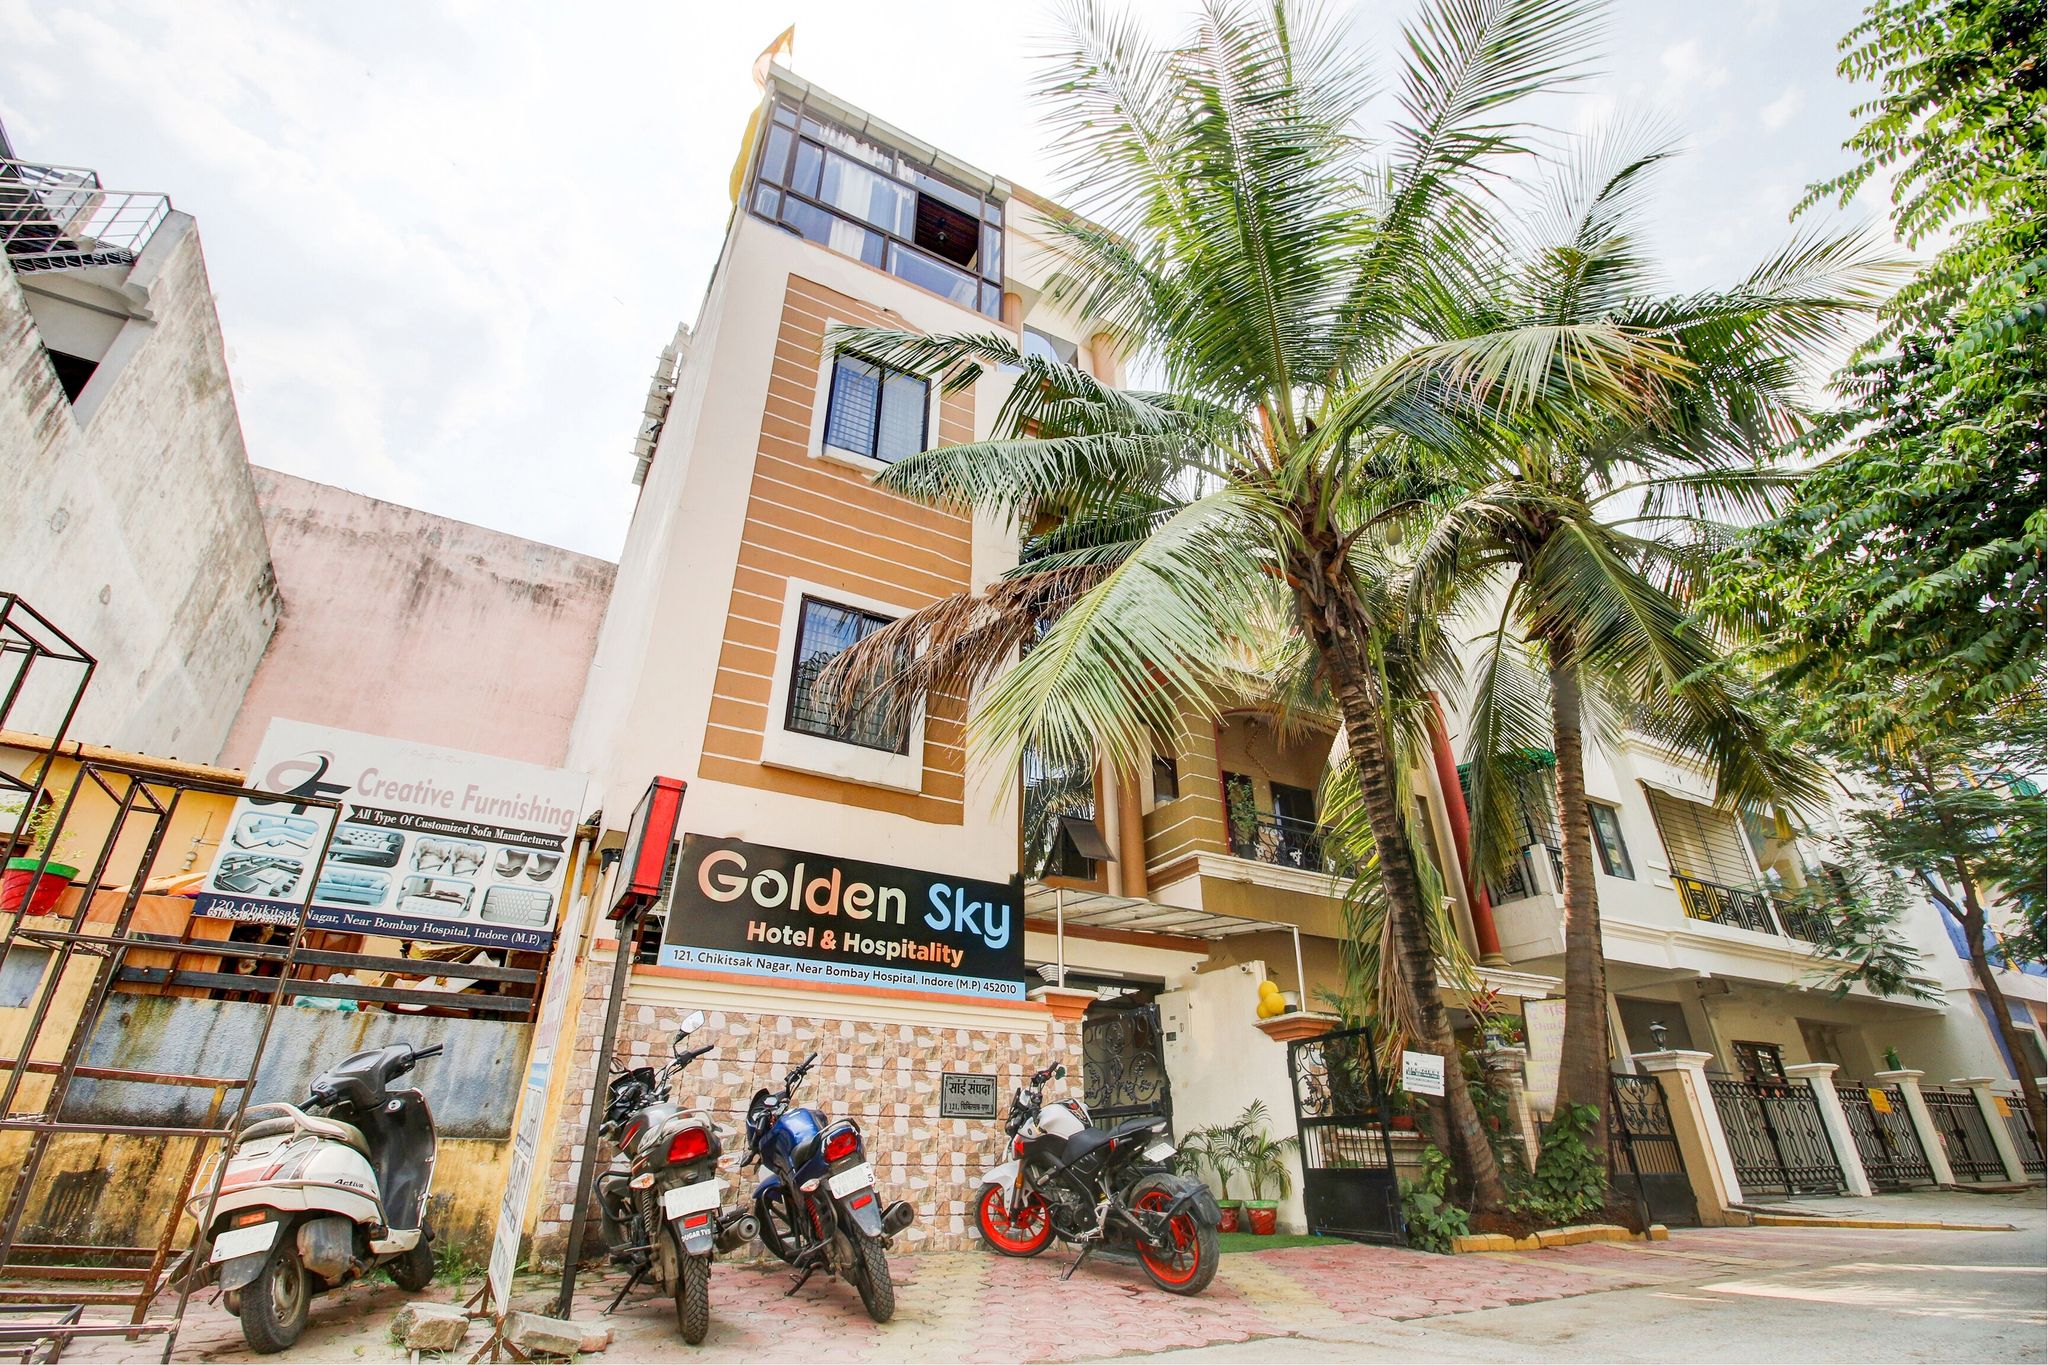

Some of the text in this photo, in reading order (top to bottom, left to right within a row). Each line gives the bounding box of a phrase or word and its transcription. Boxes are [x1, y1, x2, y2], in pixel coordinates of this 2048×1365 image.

[357, 767, 575, 834] Creative Furnishing
[354, 808, 559, 847] All Type Of Customized Sofa Manufacturers
[698, 849, 1010, 949] Golden Sky
[241, 902, 300, 920] Chikitsak
[306, 909, 339, 924] Nagar,
[343, 911, 371, 926] Near
[374, 917, 419, 933] Bombay
[422, 923, 470, 939] Hospital,
[473, 929, 509, 942] Indore
[747, 920, 964, 968] Hotel & Hospitality
[673, 949, 1017, 994] 121, Chikitsak Nagar, Near Bombay Hospital, Indore (M.P) 452010
[949, 1078, 991, 1096] सांई संपदा
[335, 1178, 364, 1188] Activa
